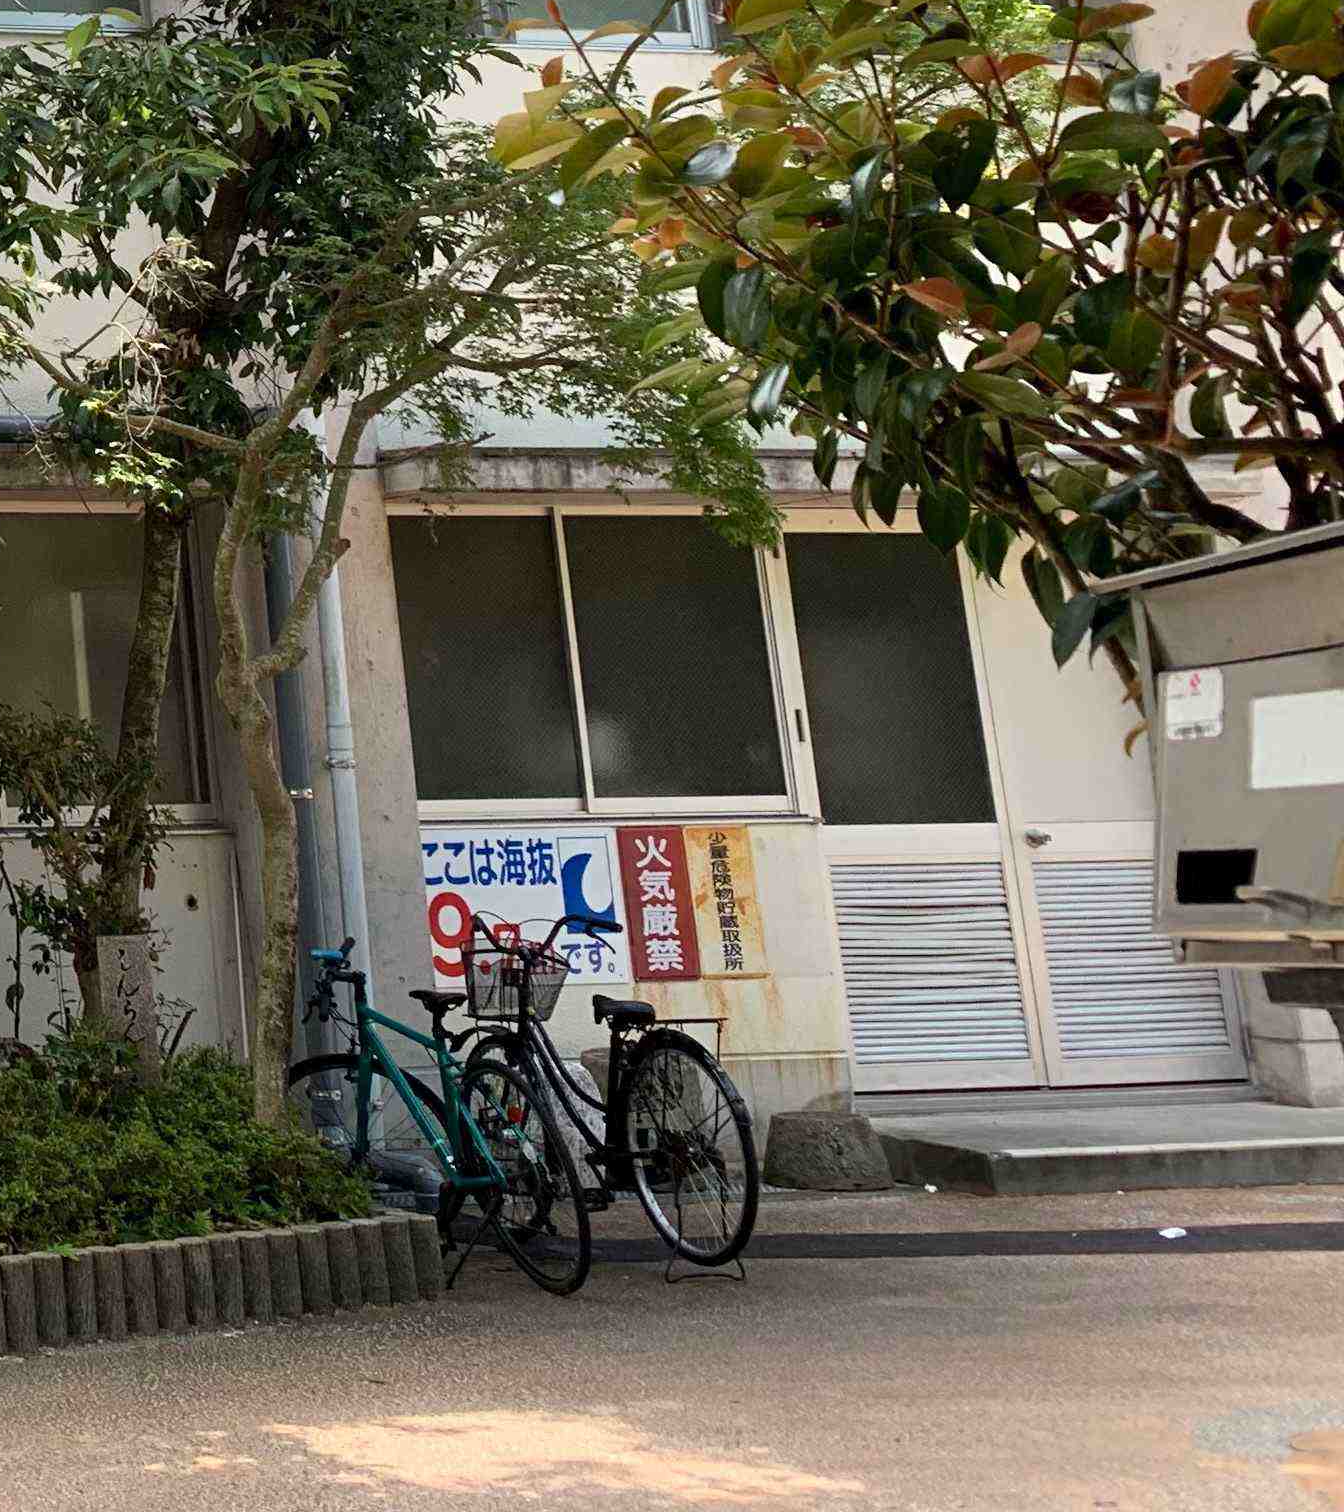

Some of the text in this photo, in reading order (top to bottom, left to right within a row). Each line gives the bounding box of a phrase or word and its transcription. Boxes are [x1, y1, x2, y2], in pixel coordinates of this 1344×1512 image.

[422, 839, 558, 887] ここは海抜
[634, 835, 685, 973] 火気厳禁
[707, 832, 745, 971] 少量危険物貯蔵取扱所
